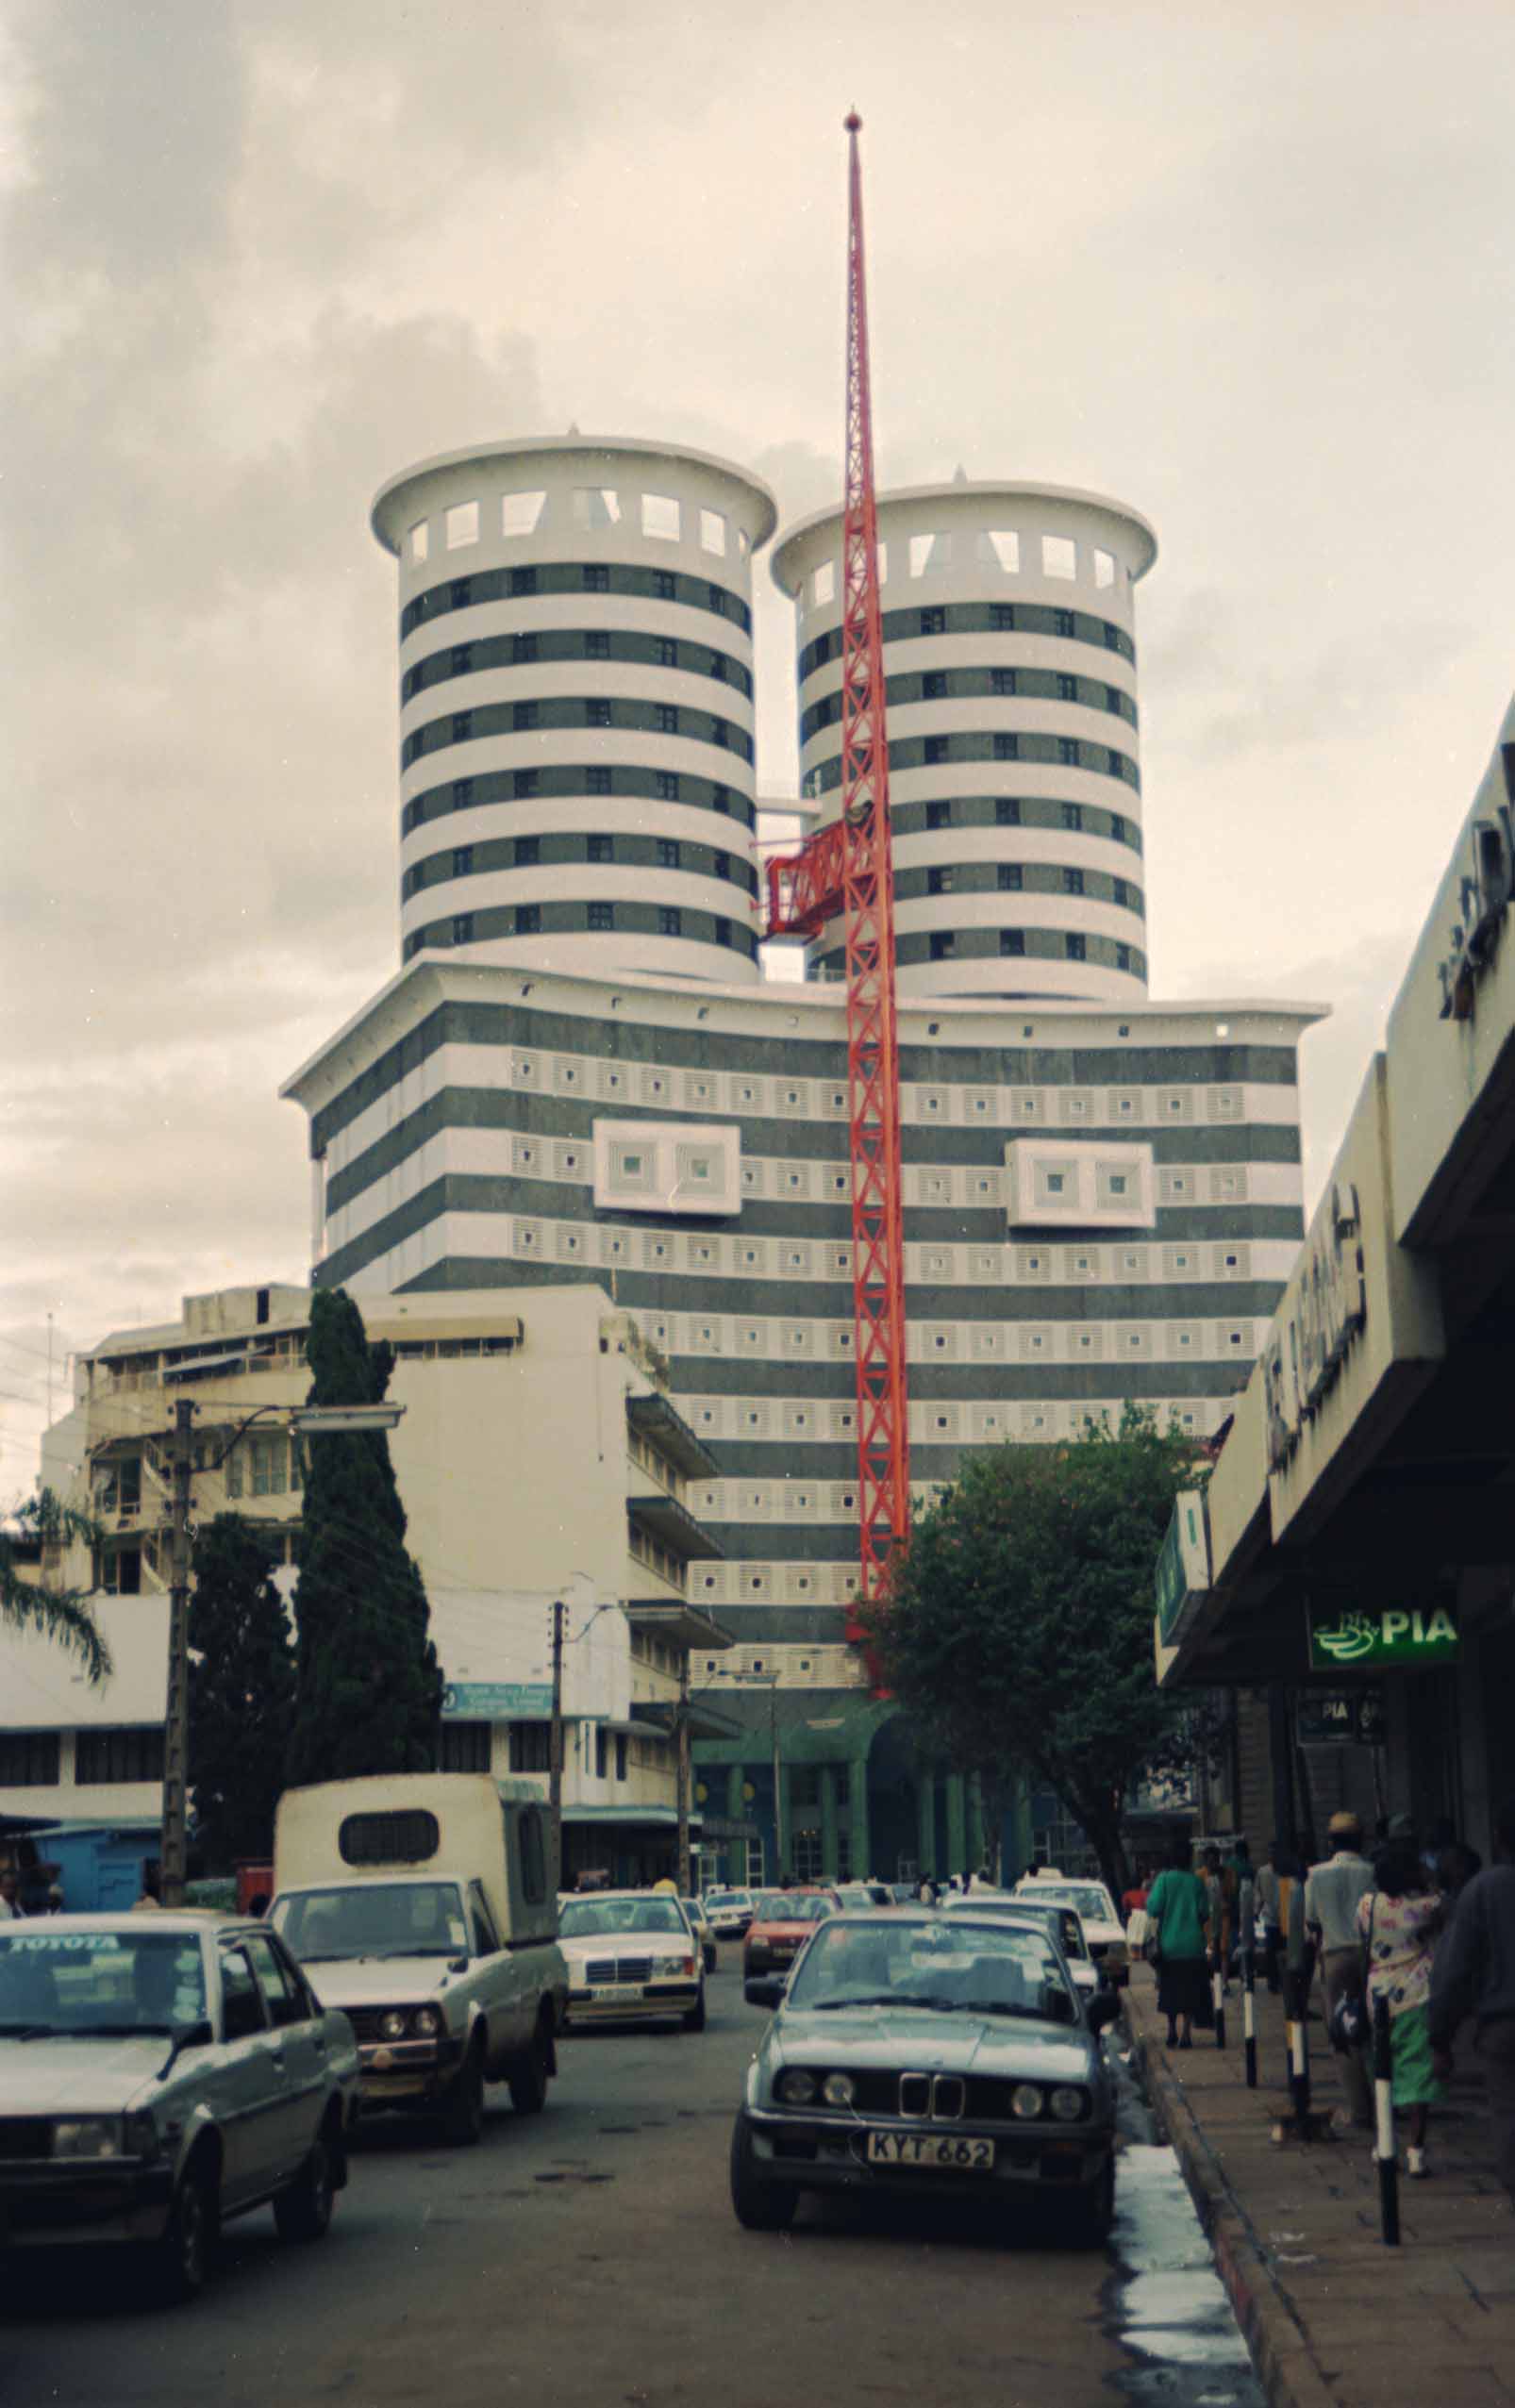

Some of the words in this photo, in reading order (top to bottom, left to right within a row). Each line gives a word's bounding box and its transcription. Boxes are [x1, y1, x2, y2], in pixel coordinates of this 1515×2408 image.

[1381, 1610, 1457, 1644] PIA
[9, 1934, 120, 1953] TOYOTA
[874, 2133, 925, 2161] KYT
[937, 2138, 991, 2167] 662
